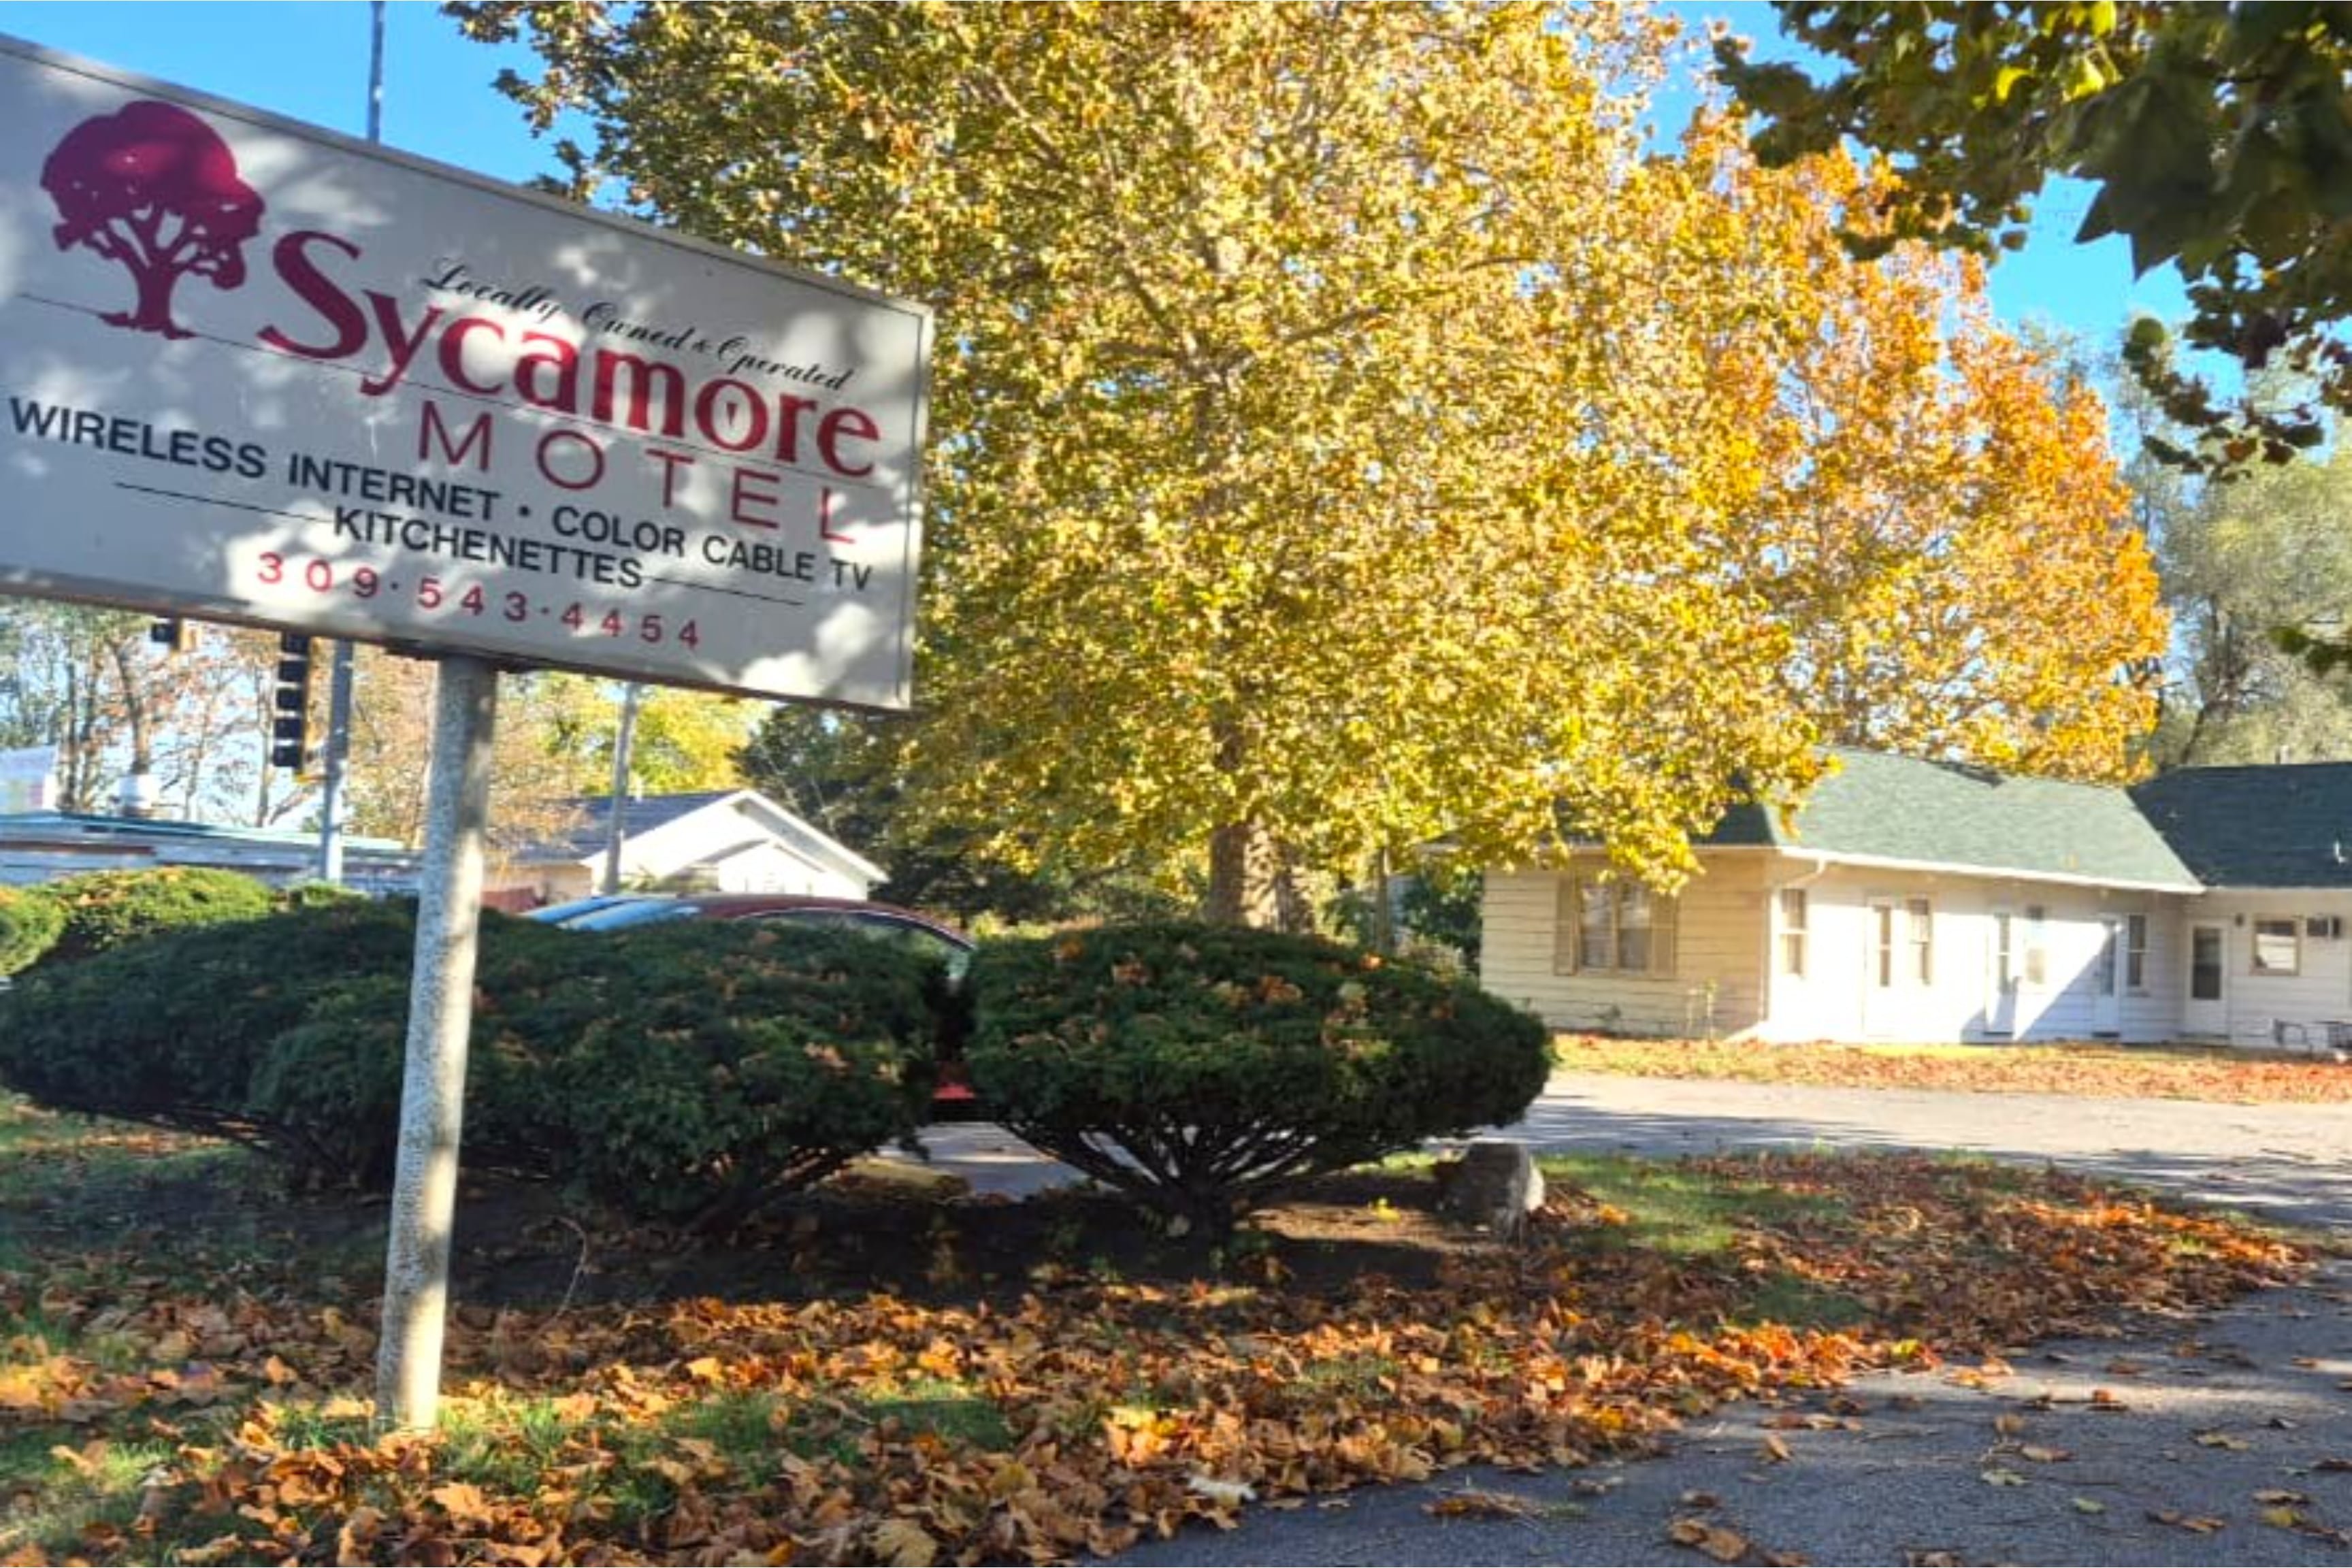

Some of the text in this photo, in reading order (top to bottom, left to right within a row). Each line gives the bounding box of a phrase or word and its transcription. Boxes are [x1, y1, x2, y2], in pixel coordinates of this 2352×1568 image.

[256, 229, 880, 477] Sycamore
[419, 257, 560, 325] Locally
[582, 301, 696, 350] Owned
[717, 336, 854, 391] Operated
[10, 396, 874, 592] WIRELESS INTERNET COLOR CABLE TV
[418, 399, 856, 544] MOTEL
[333, 506, 643, 589] KITCHENETTES
